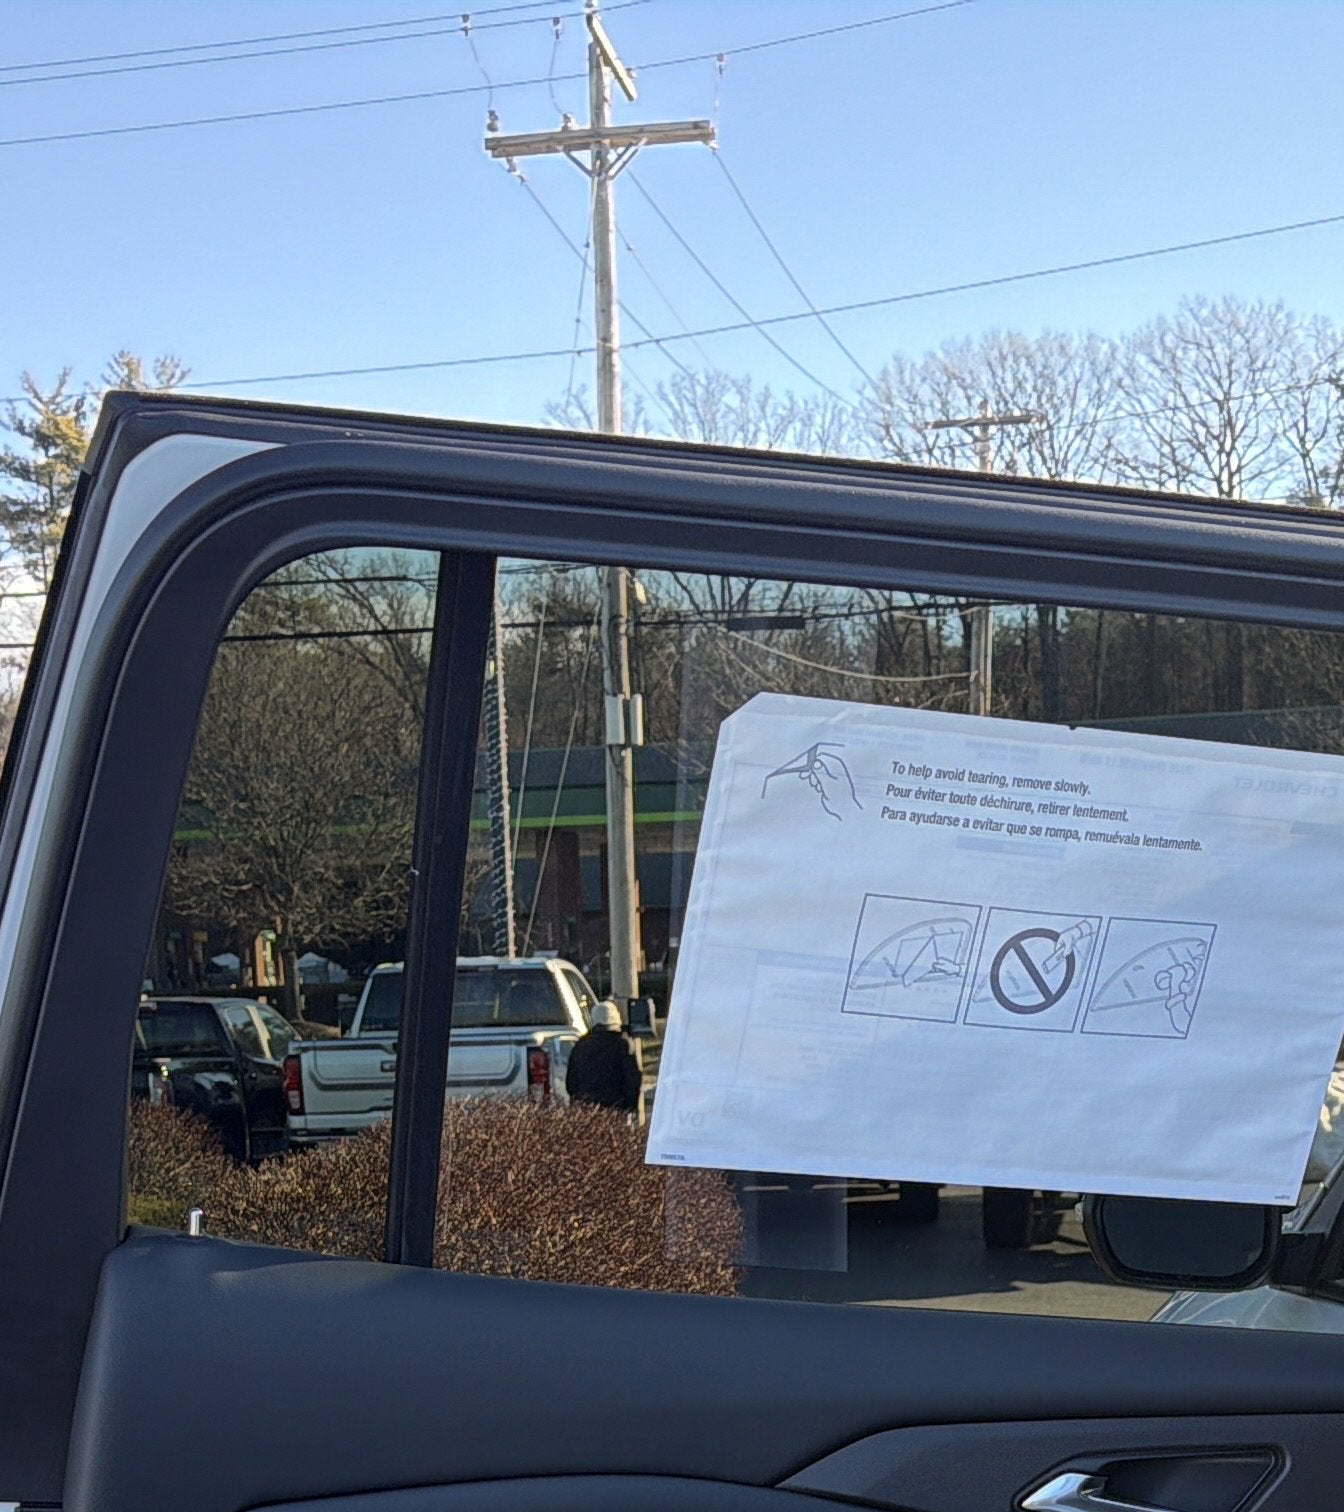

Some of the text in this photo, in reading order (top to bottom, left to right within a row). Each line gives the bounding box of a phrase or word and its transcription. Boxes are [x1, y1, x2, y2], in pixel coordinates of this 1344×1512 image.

[891, 761, 1091, 797] To help avoid tearing, remove slowly.
[885, 783, 1129, 822] Pour éviter toute déchirure, retirer lentement.
[880, 806, 1203, 851] Para ayudarse a evitar que se rompa, remuévala lentamente.
